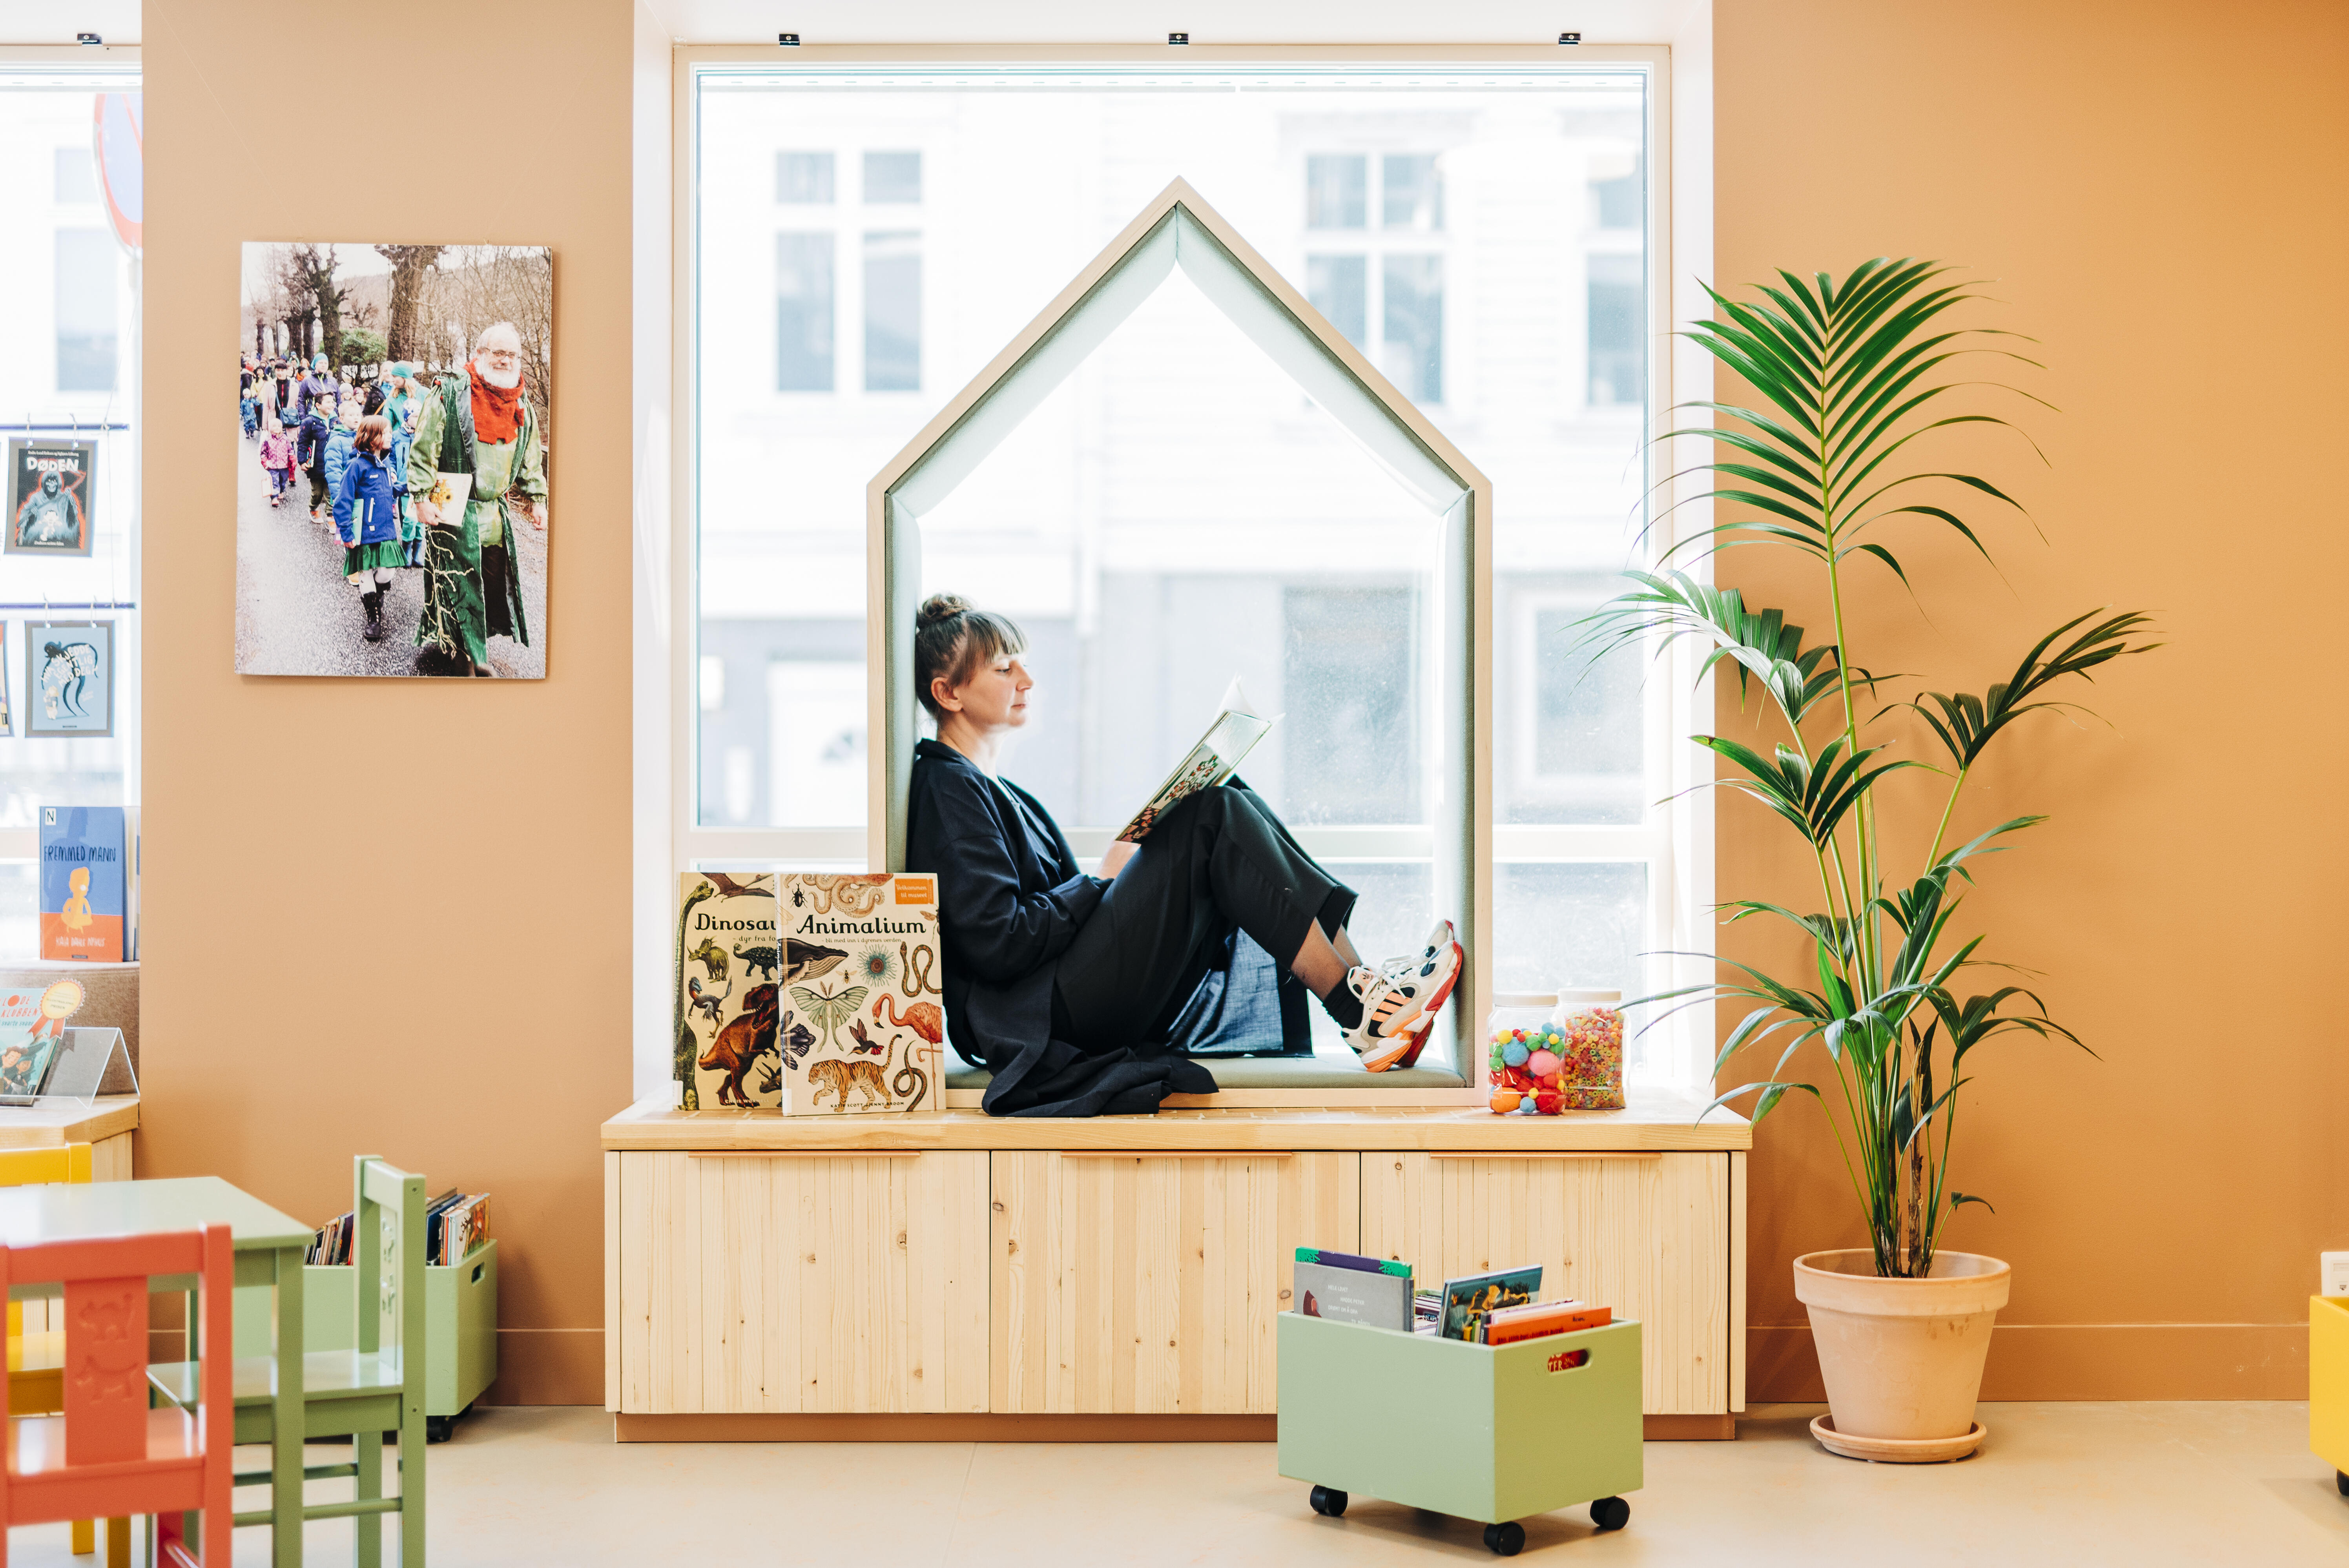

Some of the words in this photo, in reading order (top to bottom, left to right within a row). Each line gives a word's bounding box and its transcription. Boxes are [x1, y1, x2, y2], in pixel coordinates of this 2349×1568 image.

[26, 457, 79, 472] DØDEN
[51, 644, 91, 667] SKJEDDE
[47, 811, 54, 822] N
[44, 846, 86, 862] FREMMED
[89, 846, 116, 862] MANN
[796, 915, 926, 934] Animalium
[1, 1007, 38, 1017] KLUBBEN
